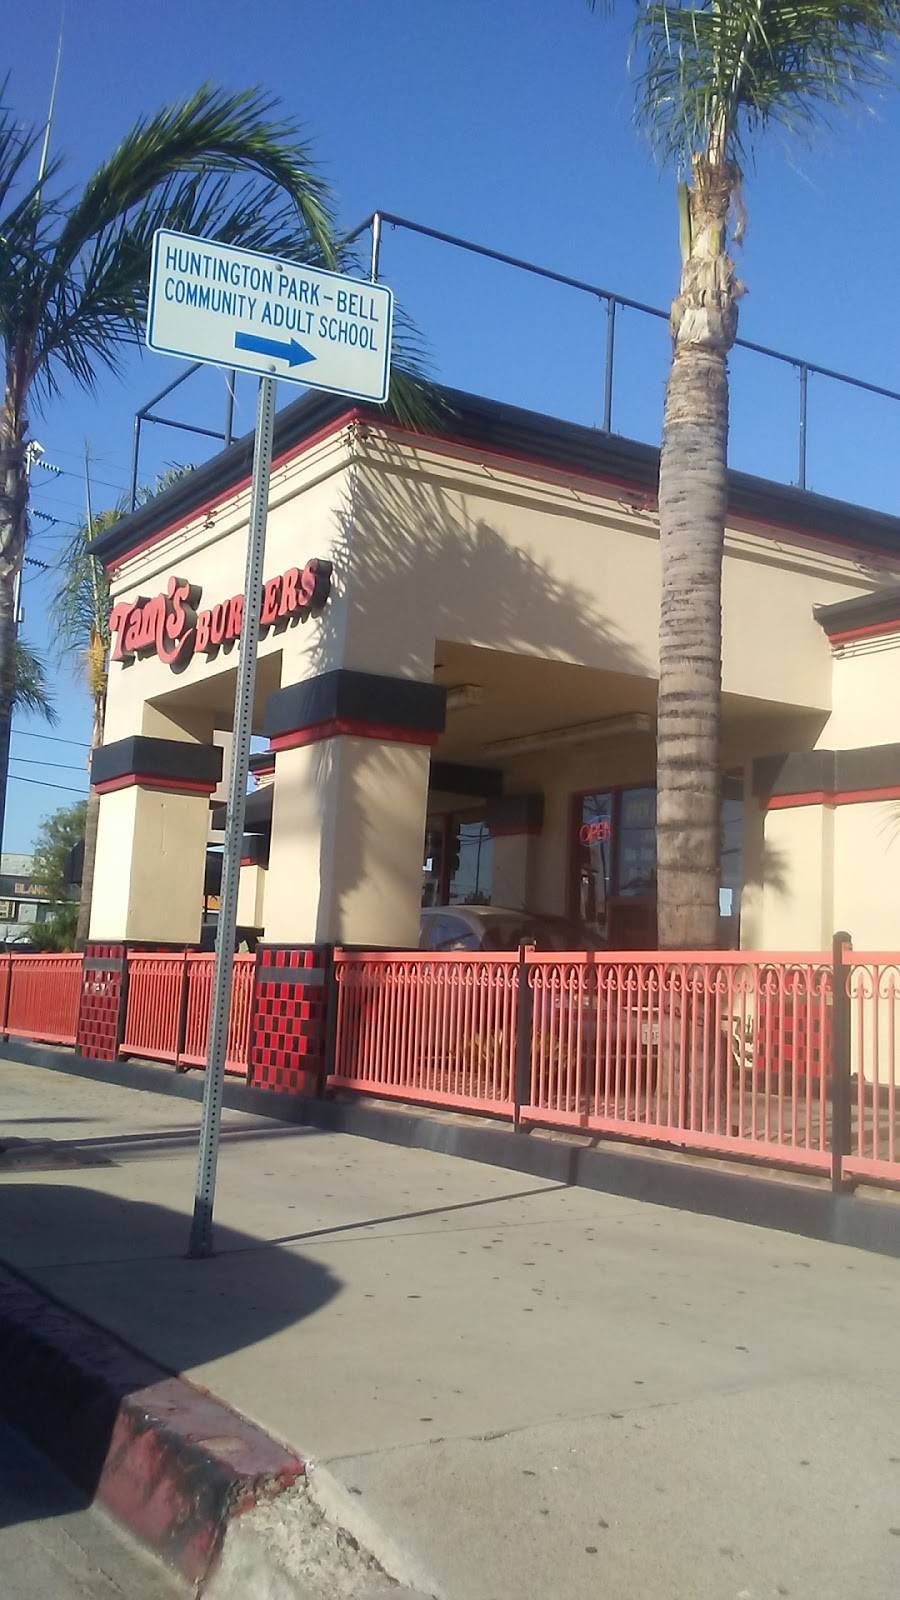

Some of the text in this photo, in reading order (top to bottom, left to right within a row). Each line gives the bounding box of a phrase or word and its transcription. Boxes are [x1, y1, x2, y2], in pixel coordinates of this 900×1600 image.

[165, 246, 273, 292] HUNTINGTON
[164, 277, 378, 351] COMMUNITY ADULT SCHOOL
[195, 558, 328, 653] BURERS
